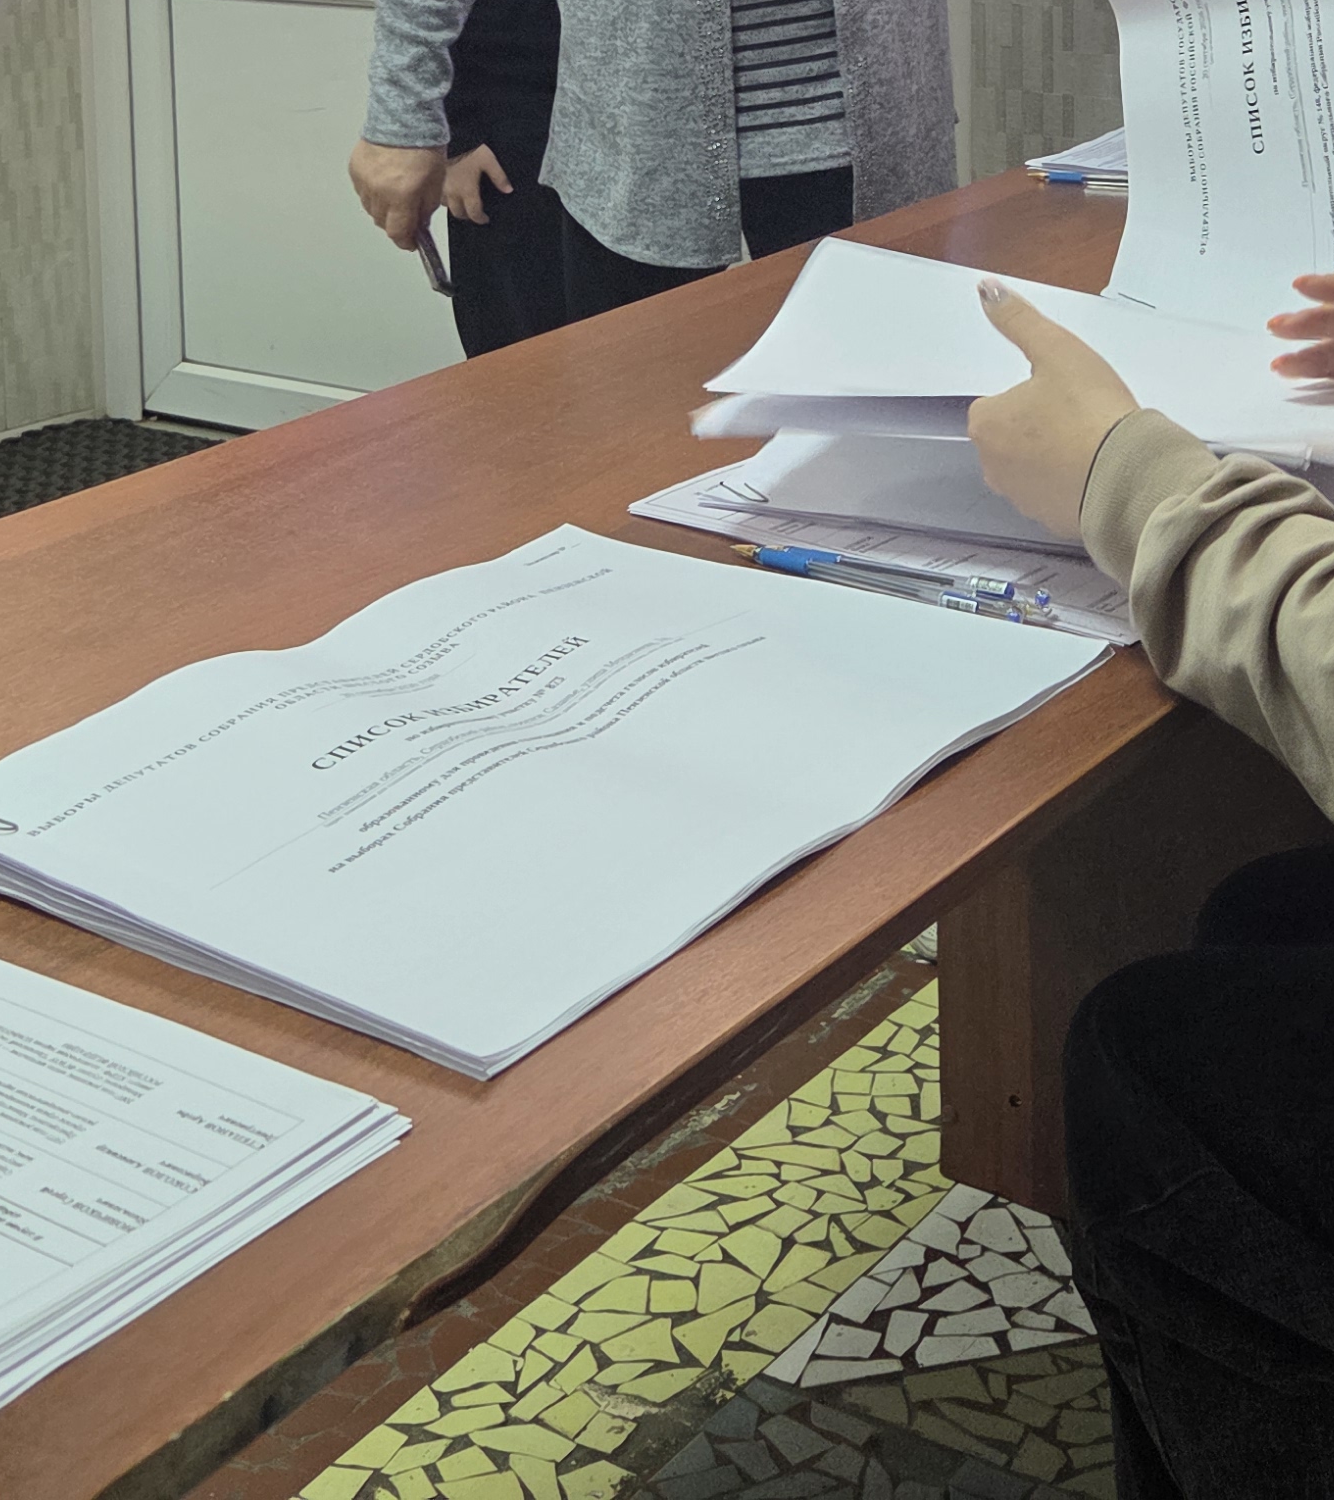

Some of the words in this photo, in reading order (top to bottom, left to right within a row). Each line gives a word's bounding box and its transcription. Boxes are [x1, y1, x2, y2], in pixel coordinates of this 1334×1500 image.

[1185, 13, 1197, 92] РОССИЙСКОЙ
[1178, 58, 1192, 129] ДЕПУТАТОВ
[1192, 95, 1206, 160] СОБРАНИЯ
[1242, 61, 1266, 155] СПИСОК
[1185, 132, 1197, 182] ВЫБОРЫ
[1198, 162, 1210, 256] ФЕДЕРАЛЬНОГО
[27, 792, 101, 837] ВЫБОРЫ
[103, 743, 197, 793] ДЕПУТАТОВ
[198, 697, 278, 743] СОБРАНИЯ
[400, 611, 488, 669] СЕРДОБСКОГО
[487, 593, 537, 613] РАЙОНА
[274, 685, 343, 711] ОБЛАСТИ
[408, 641, 461, 675] СОЗЫВА
[311, 712, 427, 770] СПИСОК
[424, 635, 590, 718] ИЗБИРАТЕЛЕЙ
[328, 862, 346, 874] на
[344, 832, 396, 863] выборах
[393, 795, 449, 832] Собрания
[448, 750, 528, 796] представителей
[587, 717, 620, 739] района
[616, 677, 670, 718] Пензенской
[359, 779, 441, 833] образованному
[440, 766, 461, 780] для
